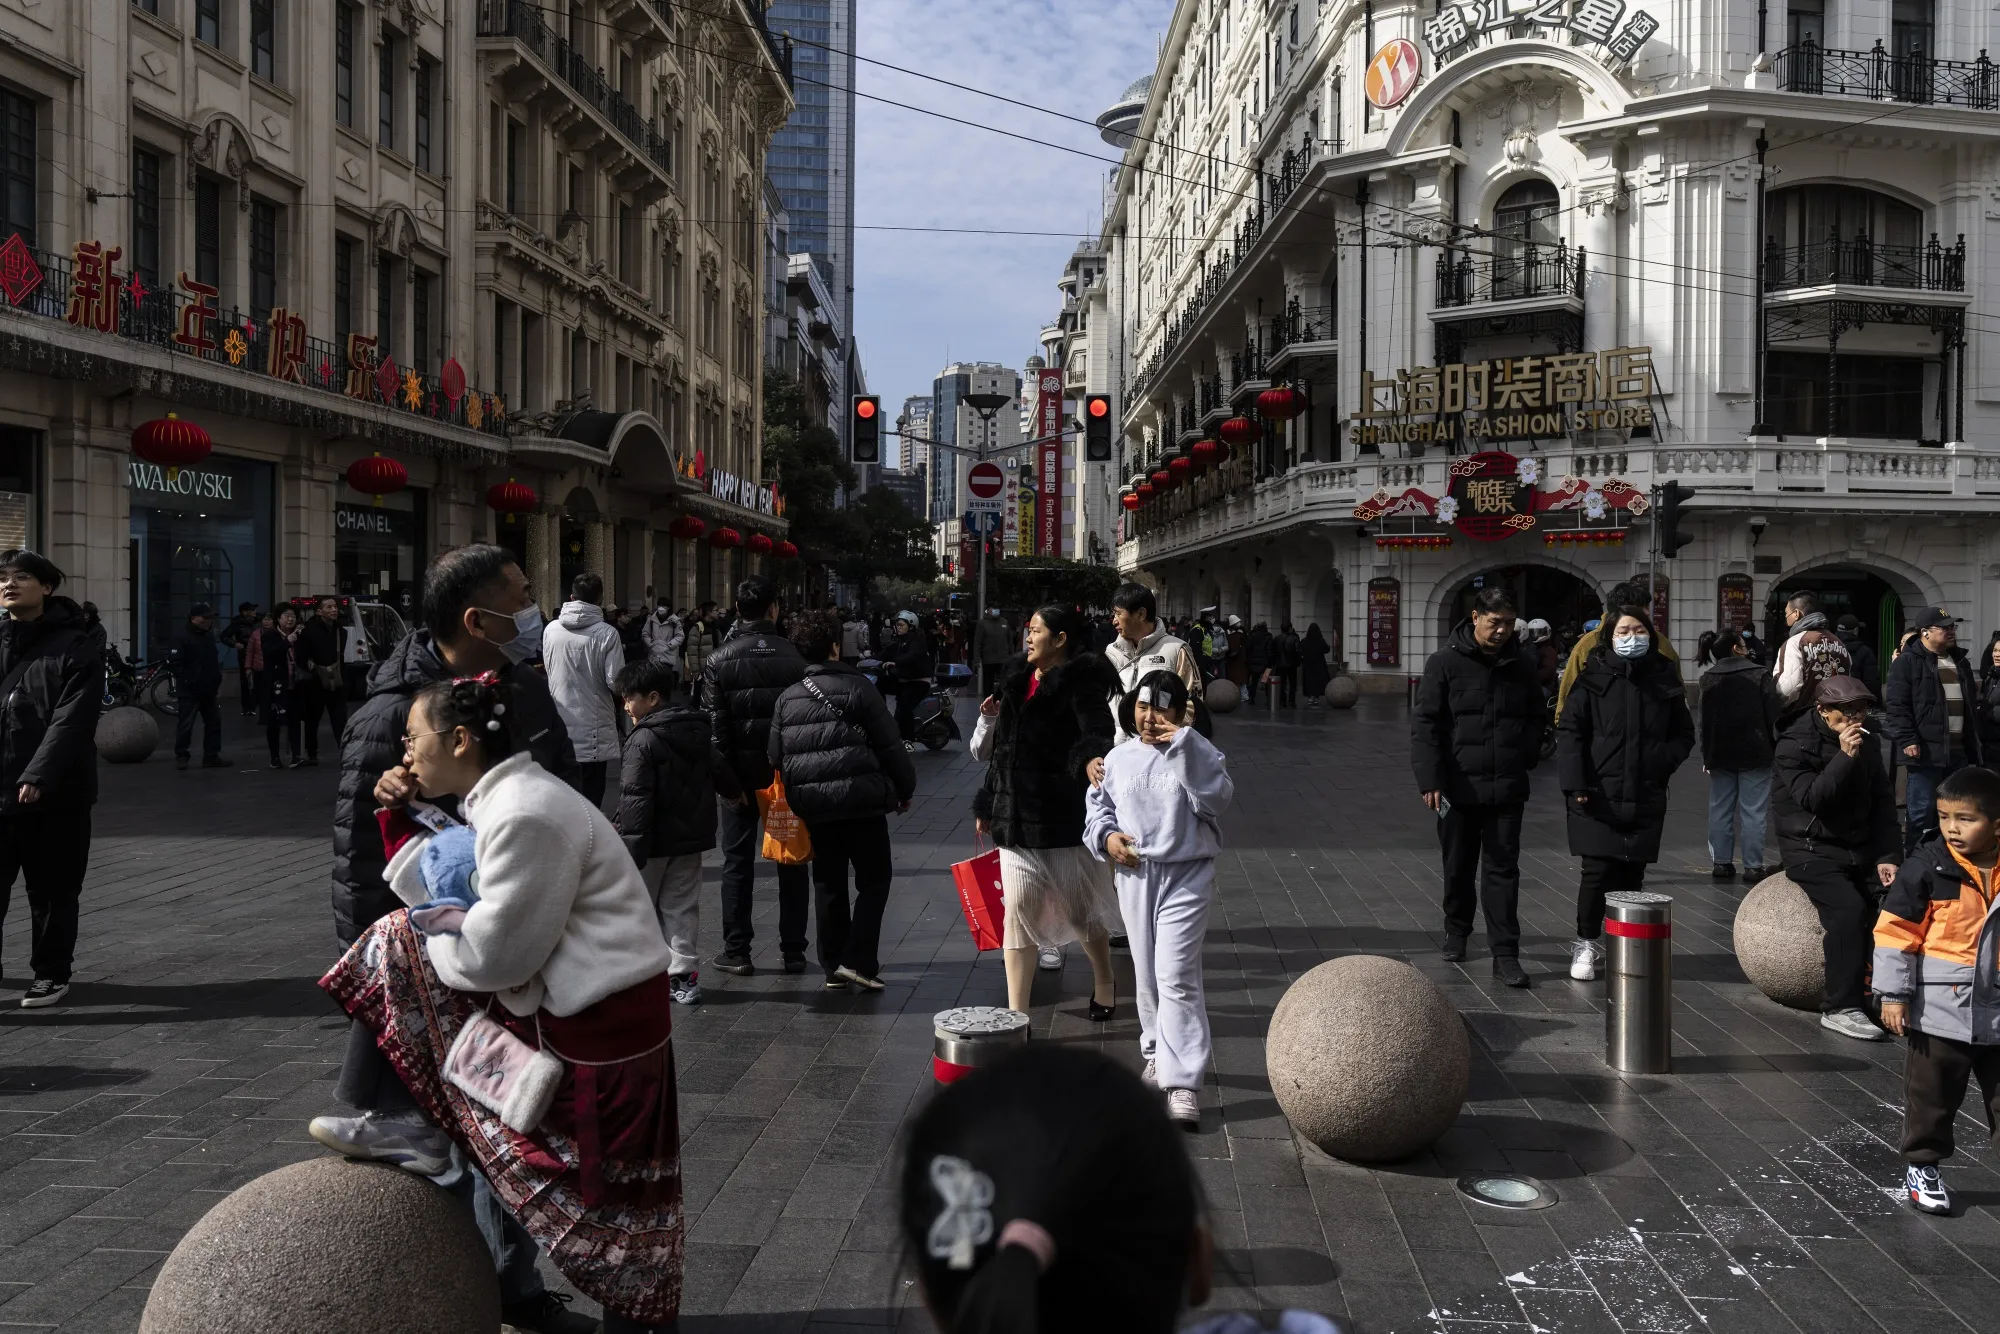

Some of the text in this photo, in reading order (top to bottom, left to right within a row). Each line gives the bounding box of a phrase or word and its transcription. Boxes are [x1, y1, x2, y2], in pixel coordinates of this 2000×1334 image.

[1350, 346, 1653, 420] 上海时装商店
[1349, 404, 1653, 445] SHANGHAI FASHION STORE
[712, 467, 774, 516] HAPPY NEW YEAR
[1005, 479, 1018, 532] 新世界城
[1046, 499, 1055, 516] First
[336, 510, 393, 533] CHANEL
